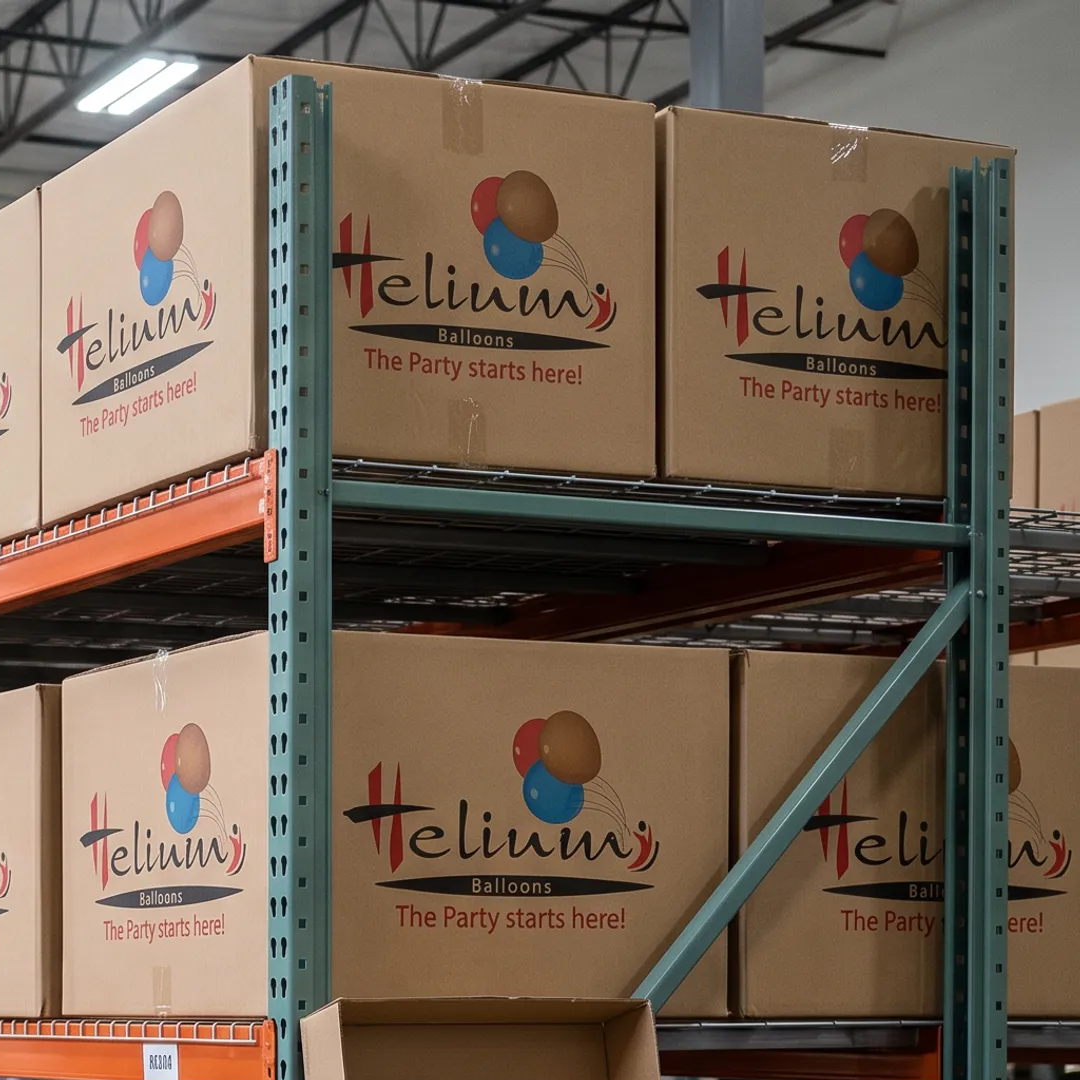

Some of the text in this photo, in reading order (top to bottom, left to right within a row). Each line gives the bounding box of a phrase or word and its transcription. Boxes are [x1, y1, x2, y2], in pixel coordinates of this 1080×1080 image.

[332, 212, 593, 318] Helium
[695, 245, 948, 347] Helium
[57, 291, 202, 392] Helium
[438, 328, 514, 348] Balloons
[113, 365, 155, 392] Balloons
[364, 348, 582, 385] The Party starts here!
[806, 356, 877, 377] Balloons
[80, 371, 196, 437] The Party starts here!
[739, 376, 941, 413] The Party starts here!
[343, 760, 632, 874] Helium
[803, 776, 1048, 880] Helim
[80, 790, 228, 891] Helium
[140, 890, 183, 906] Balloons
[471, 877, 552, 894] Balloons
[103, 913, 225, 944] The Party starts here!
[396, 904, 626, 934] The Party starts here!
[840, 910, 1044, 938] The Party ere!
